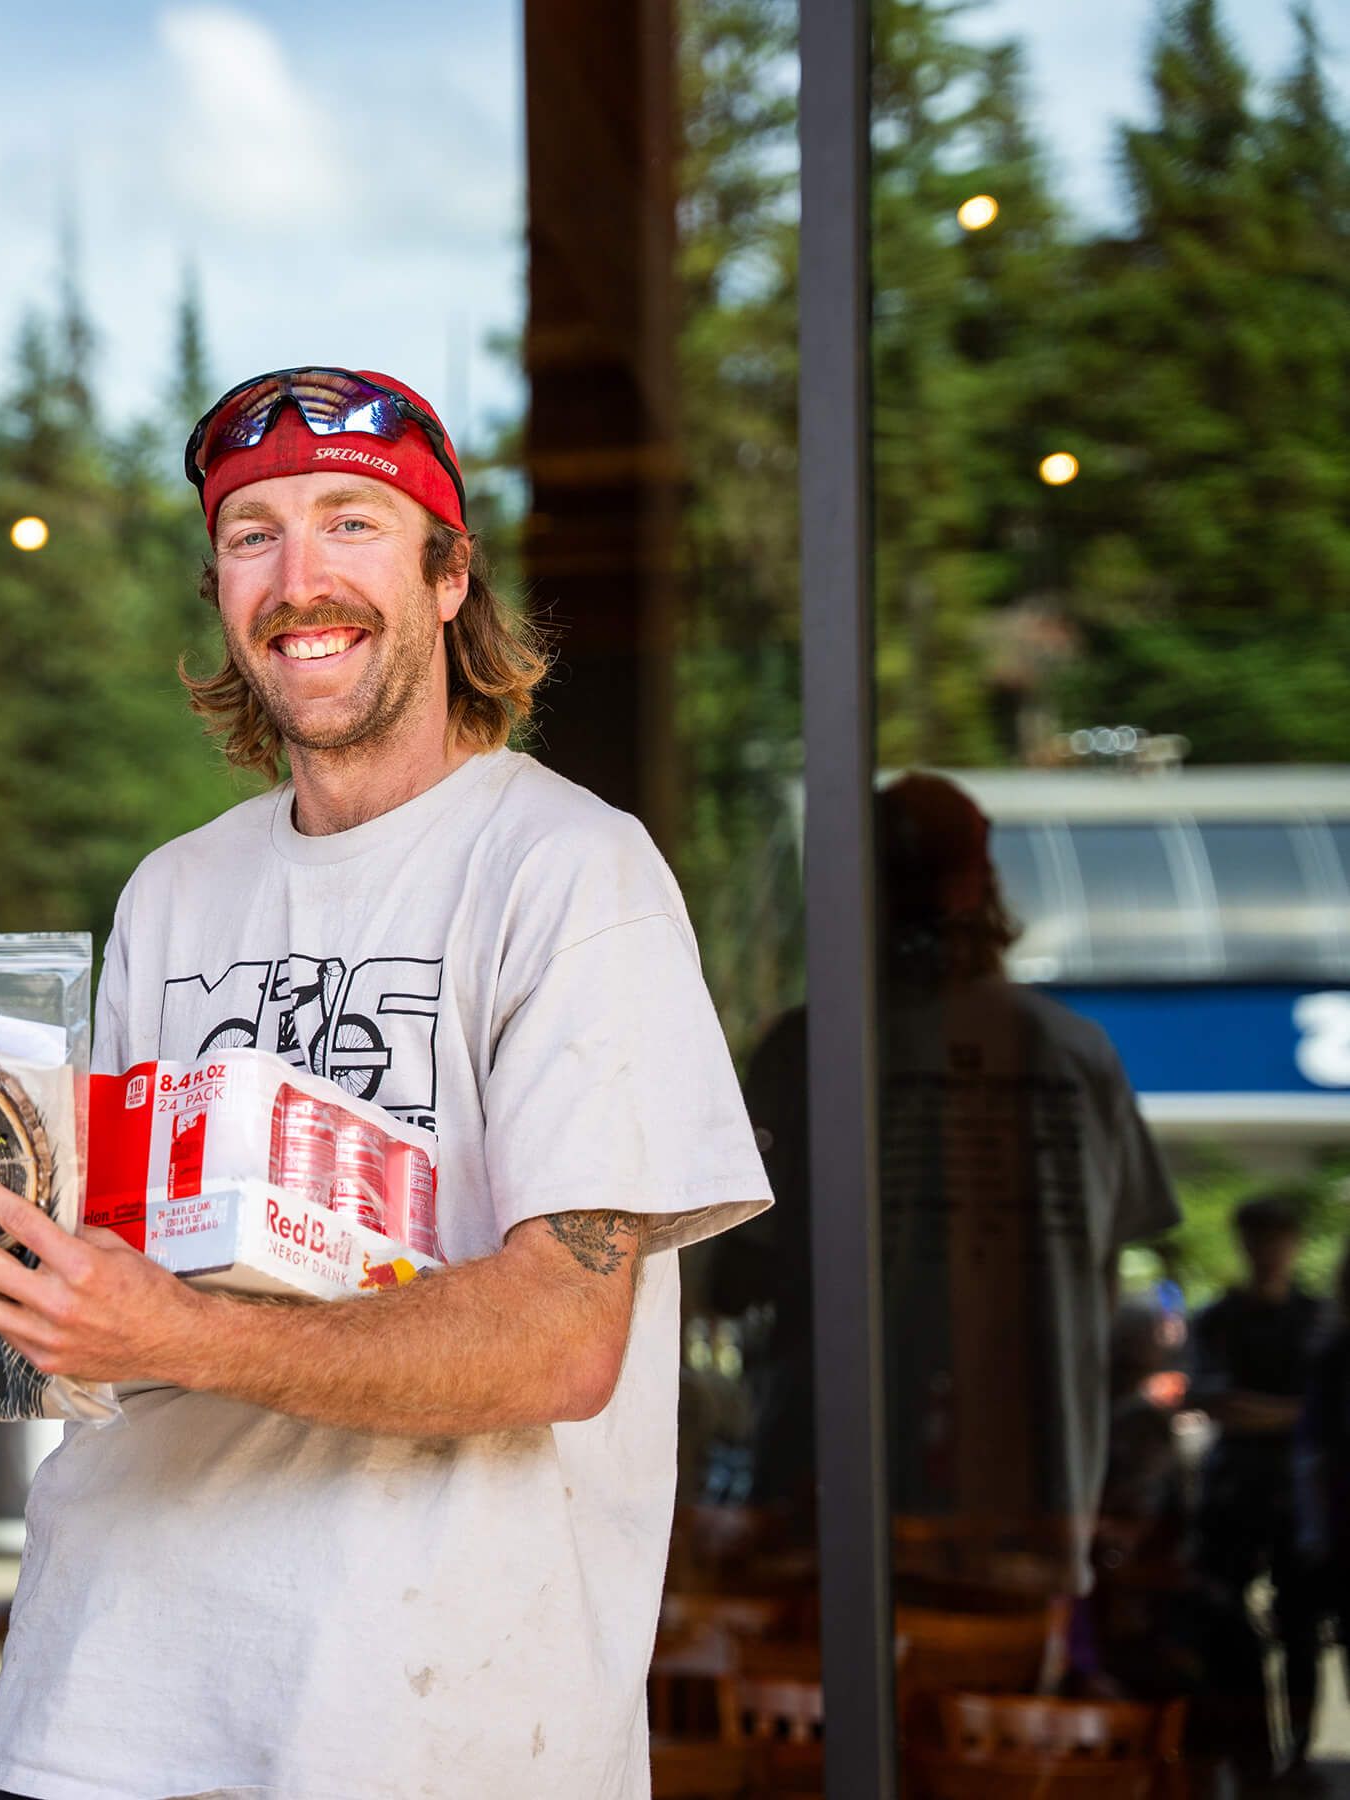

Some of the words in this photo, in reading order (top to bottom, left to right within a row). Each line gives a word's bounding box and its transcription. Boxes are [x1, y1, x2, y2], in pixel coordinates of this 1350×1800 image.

[312, 447, 399, 476] SPECIALIZED
[128, 1078, 144, 1094] 110
[159, 1070, 190, 1093] 8.4
[193, 1070, 205, 1086] FL
[206, 1064, 227, 1079] OZ
[158, 1098, 178, 1113] 24
[185, 1085, 226, 1108] PACK
[266, 1198, 309, 1248] Red
[310, 1218, 355, 1266] Bull
[267, 1239, 310, 1271] NERGY
[311, 1260, 349, 1288] DRINK
